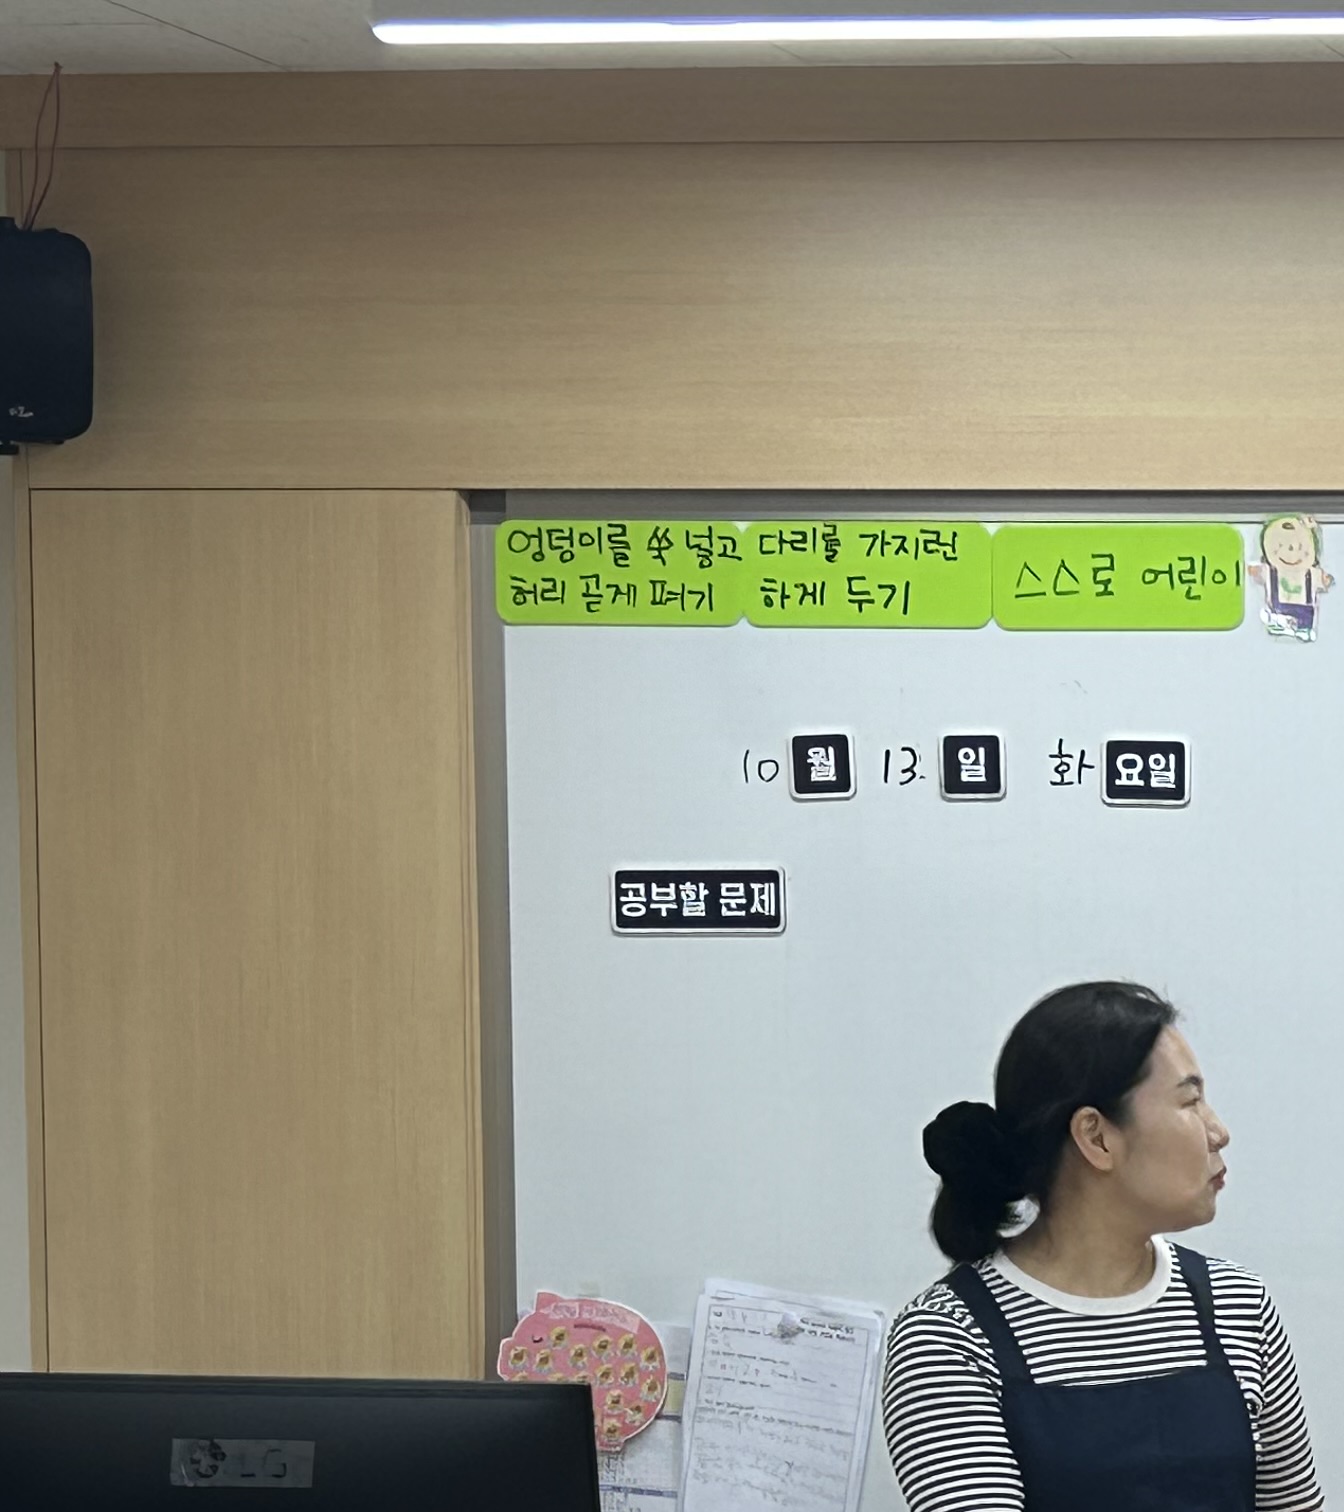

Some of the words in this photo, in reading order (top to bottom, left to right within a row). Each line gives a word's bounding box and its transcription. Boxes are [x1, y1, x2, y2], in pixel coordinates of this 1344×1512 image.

[507, 523, 631, 568] 엉덩이를
[647, 525, 674, 567] 쑥
[685, 525, 743, 569] 넣고
[759, 522, 842, 563] 다리를
[858, 528, 959, 562] 가지런
[509, 574, 566, 607] 허리
[579, 573, 637, 613] 곧게
[649, 579, 714, 612] 펴기
[760, 577, 827, 611] 하게
[846, 575, 911, 616] 두기
[1015, 553, 1116, 599] 스스로
[1141, 555, 1241, 601] 어린이
[743, 748, 780, 784] 10
[806, 745, 838, 783] 월
[957, 746, 987, 784] 일
[1048, 738, 1096, 787] 화
[1114, 752, 1177, 790] 요일
[619, 881, 710, 918] 공부할
[719, 882, 776, 917] 문제
